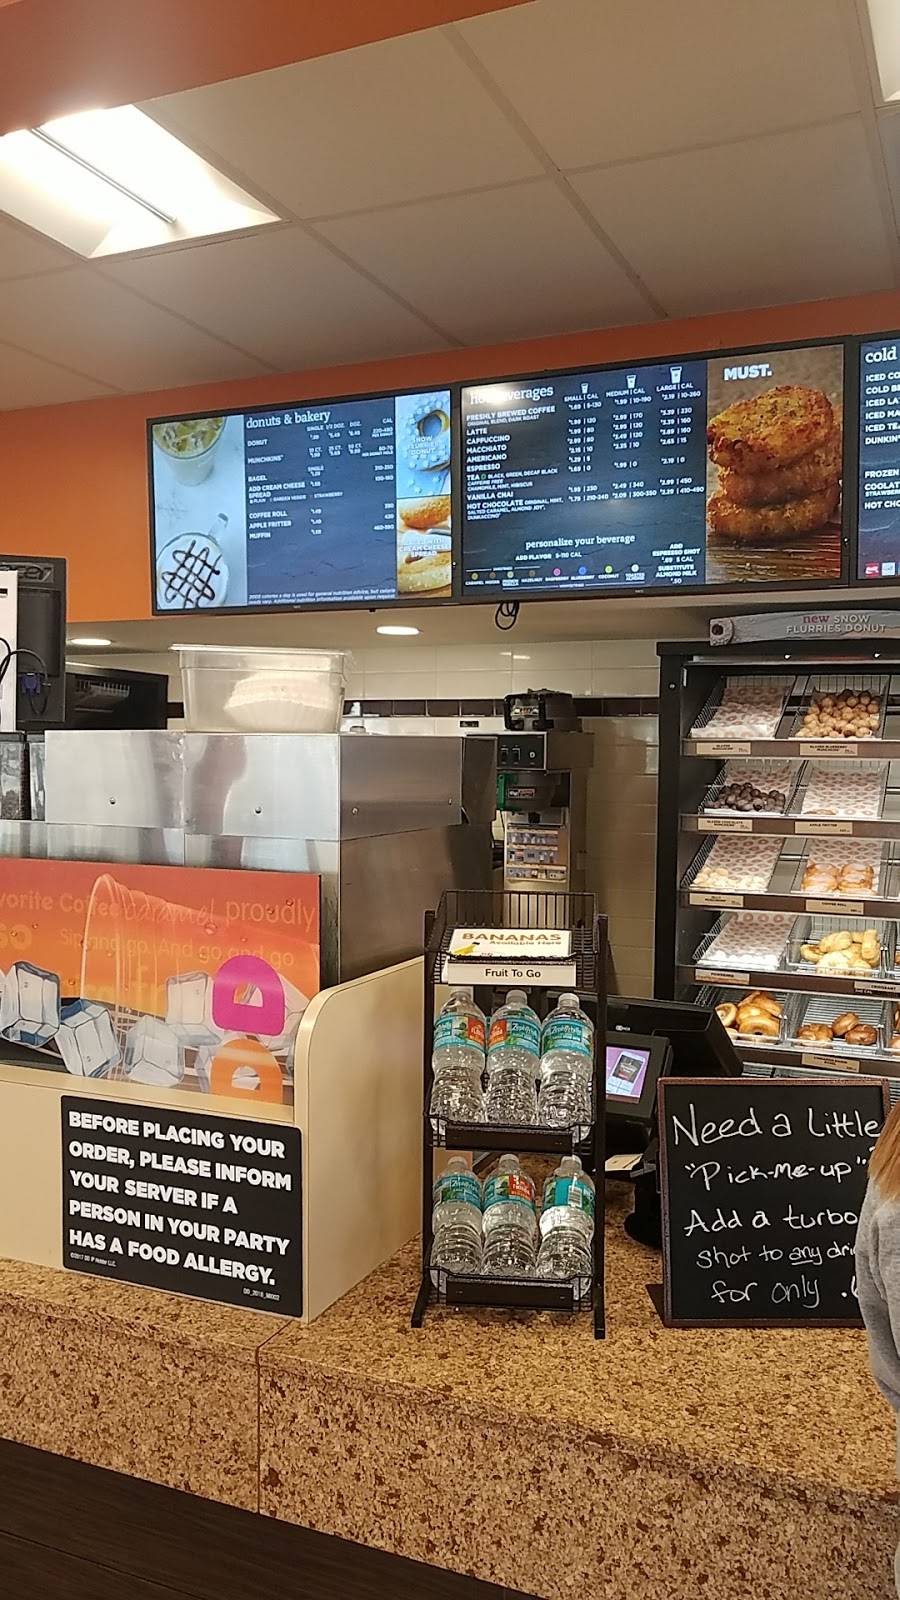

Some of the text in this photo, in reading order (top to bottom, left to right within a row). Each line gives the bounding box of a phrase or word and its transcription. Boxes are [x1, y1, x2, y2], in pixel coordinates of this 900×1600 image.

[865, 346, 897, 363] cold
[724, 363, 772, 381] MUST.
[866, 373, 886, 382] ICED
[865, 385, 889, 395] COLD
[865, 398, 886, 407] ICED
[466, 405, 556, 421] FRESHLY BREWED COFFEE
[865, 410, 886, 420] ICED
[246, 411, 331, 429] donuts & bakery
[466, 428, 488, 436] LATTE
[865, 424, 886, 432] ICED
[466, 435, 511, 445] CAPPUCCINO
[466, 445, 507, 454] MACCHIATO
[466, 454, 507, 463] AMERICANO
[466, 463, 501, 472] ESPRESSO
[864, 469, 899, 478] FROZEN
[466, 491, 514, 501] VANILLA CHAI
[482, 500, 524, 508] CHOCOLATE
[864, 501, 883, 510] HOT
[525, 535, 636, 551] personalize your beverage
[803, 614, 870, 624] new SNOW
[786, 623, 886, 634] FLURRIES DONUT
[226, 898, 316, 933] proudly
[462, 933, 561, 941] BANANAS
[485, 968, 541, 978] Fruit To Go
[672, 1103, 763, 1147] Need
[772, 1113, 792, 1138] a
[68, 1110, 285, 1159] BEFORE PLACING YOUR
[68, 1141, 292, 1191] ORDER, PLEASE INFORM
[69, 1170, 238, 1214] YOUR SERVER IF A
[684, 1204, 859, 1237] Add a turbo
[69, 1200, 290, 1256] PERSON IN YOUR PARTY
[69, 1229, 276, 1286] HAS A FOOD ALLERGY.
[759, 1245, 783, 1262] to
[789, 1246, 823, 1266] any
[711, 1280, 758, 1304] for
